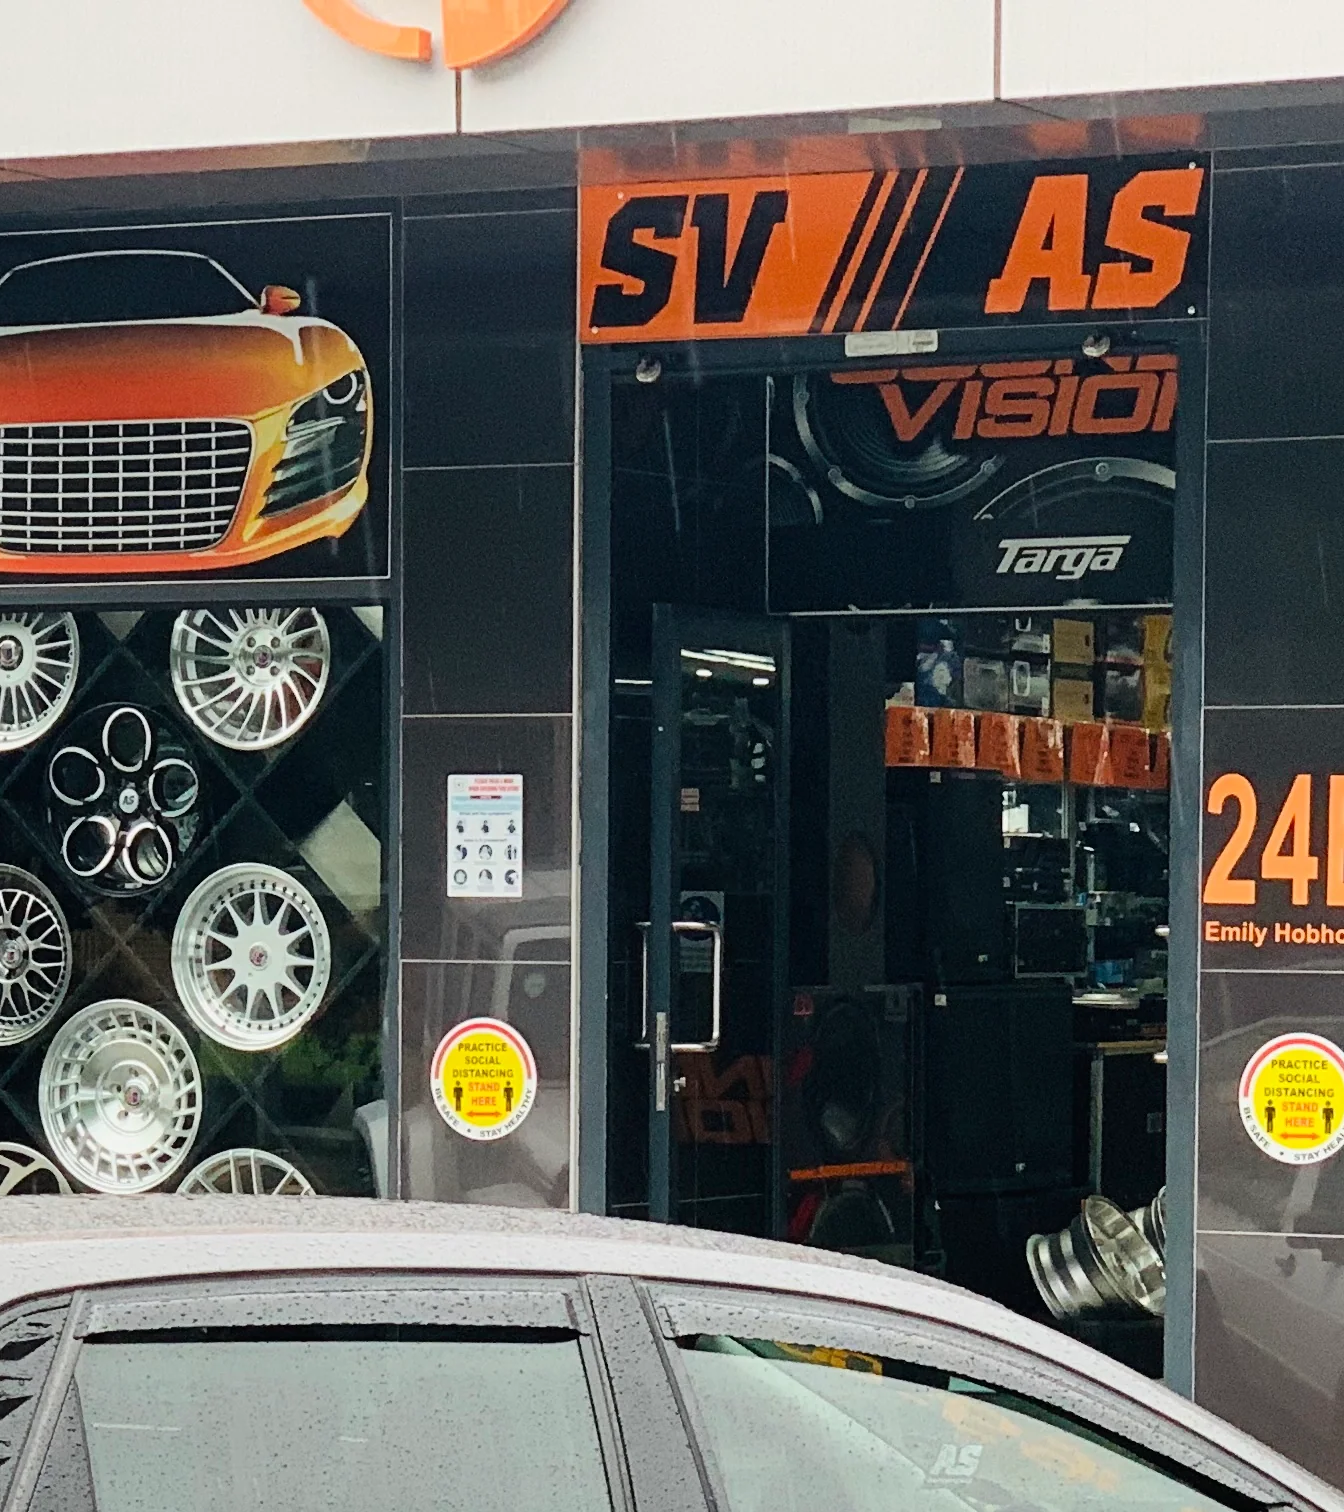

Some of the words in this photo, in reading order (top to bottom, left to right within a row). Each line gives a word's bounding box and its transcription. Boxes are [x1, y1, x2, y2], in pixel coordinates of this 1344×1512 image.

[984, 167, 1204, 313] AS
[590, 190, 788, 328] SV
[996, 535, 1130, 579] Targa
[1204, 921, 1267, 948] Emily
[458, 1043, 507, 1052] PRACTICE
[464, 1056, 501, 1065] SOCIAL
[1271, 1060, 1329, 1070] PRACTICE
[452, 1069, 514, 1078] DISTANCING
[1278, 1073, 1320, 1083] SOCIAL
[468, 1082, 500, 1092] STAND
[1264, 1087, 1334, 1098] DISTANCING
[435, 1087, 443, 1101] BE
[441, 1104, 460, 1126] SAFE
[471, 1096, 496, 1106] HERE
[1282, 1102, 1318, 1112] STAND
[479, 1128, 503, 1138] STAY
[505, 1088, 532, 1129] HEALTHY
[1243, 1106, 1253, 1121] BE
[1250, 1124, 1270, 1150] SAFE
[1285, 1117, 1315, 1128] HERE
[1293, 1150, 1320, 1161] STAY
